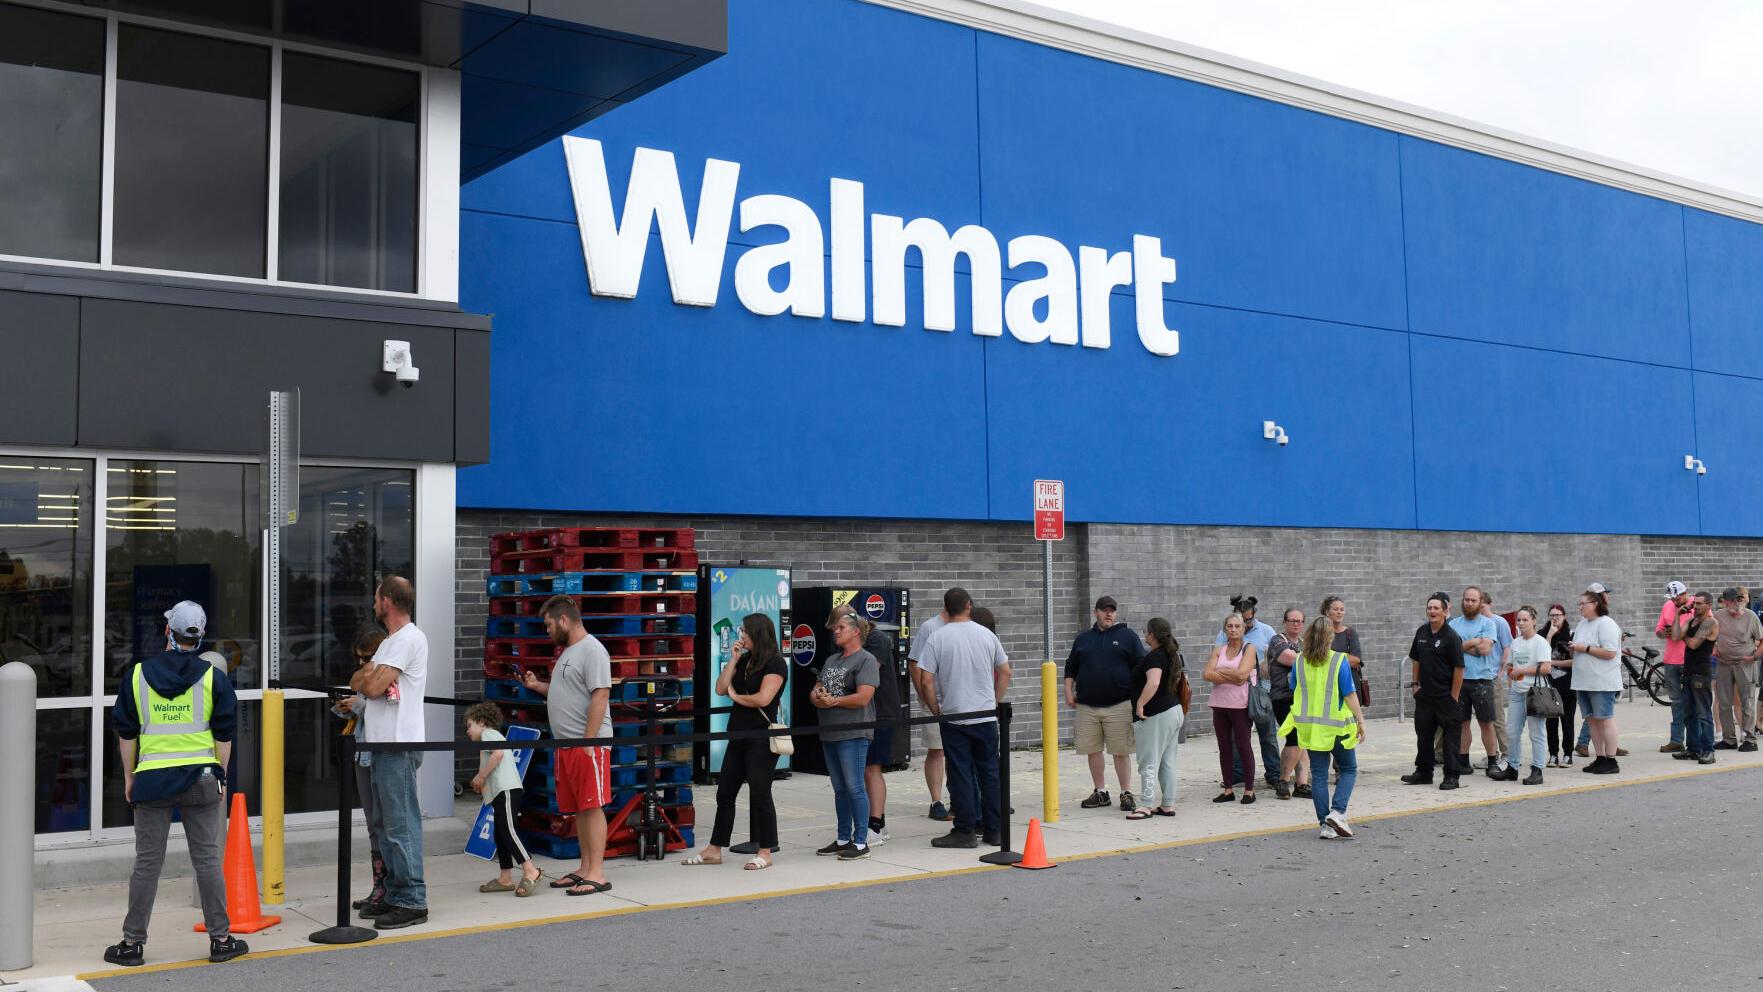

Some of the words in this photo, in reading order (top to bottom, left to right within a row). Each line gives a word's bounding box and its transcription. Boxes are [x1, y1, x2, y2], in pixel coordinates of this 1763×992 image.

[561, 134, 1179, 356] Walmart
[1039, 484, 1058, 495] FIRE
[1039, 498, 1060, 509] LANE
[730, 590, 779, 612] DASANI
[793, 641, 815, 649] PEPSI
[153, 703, 191, 712] Walmart
[162, 713, 181, 721] Fuel
